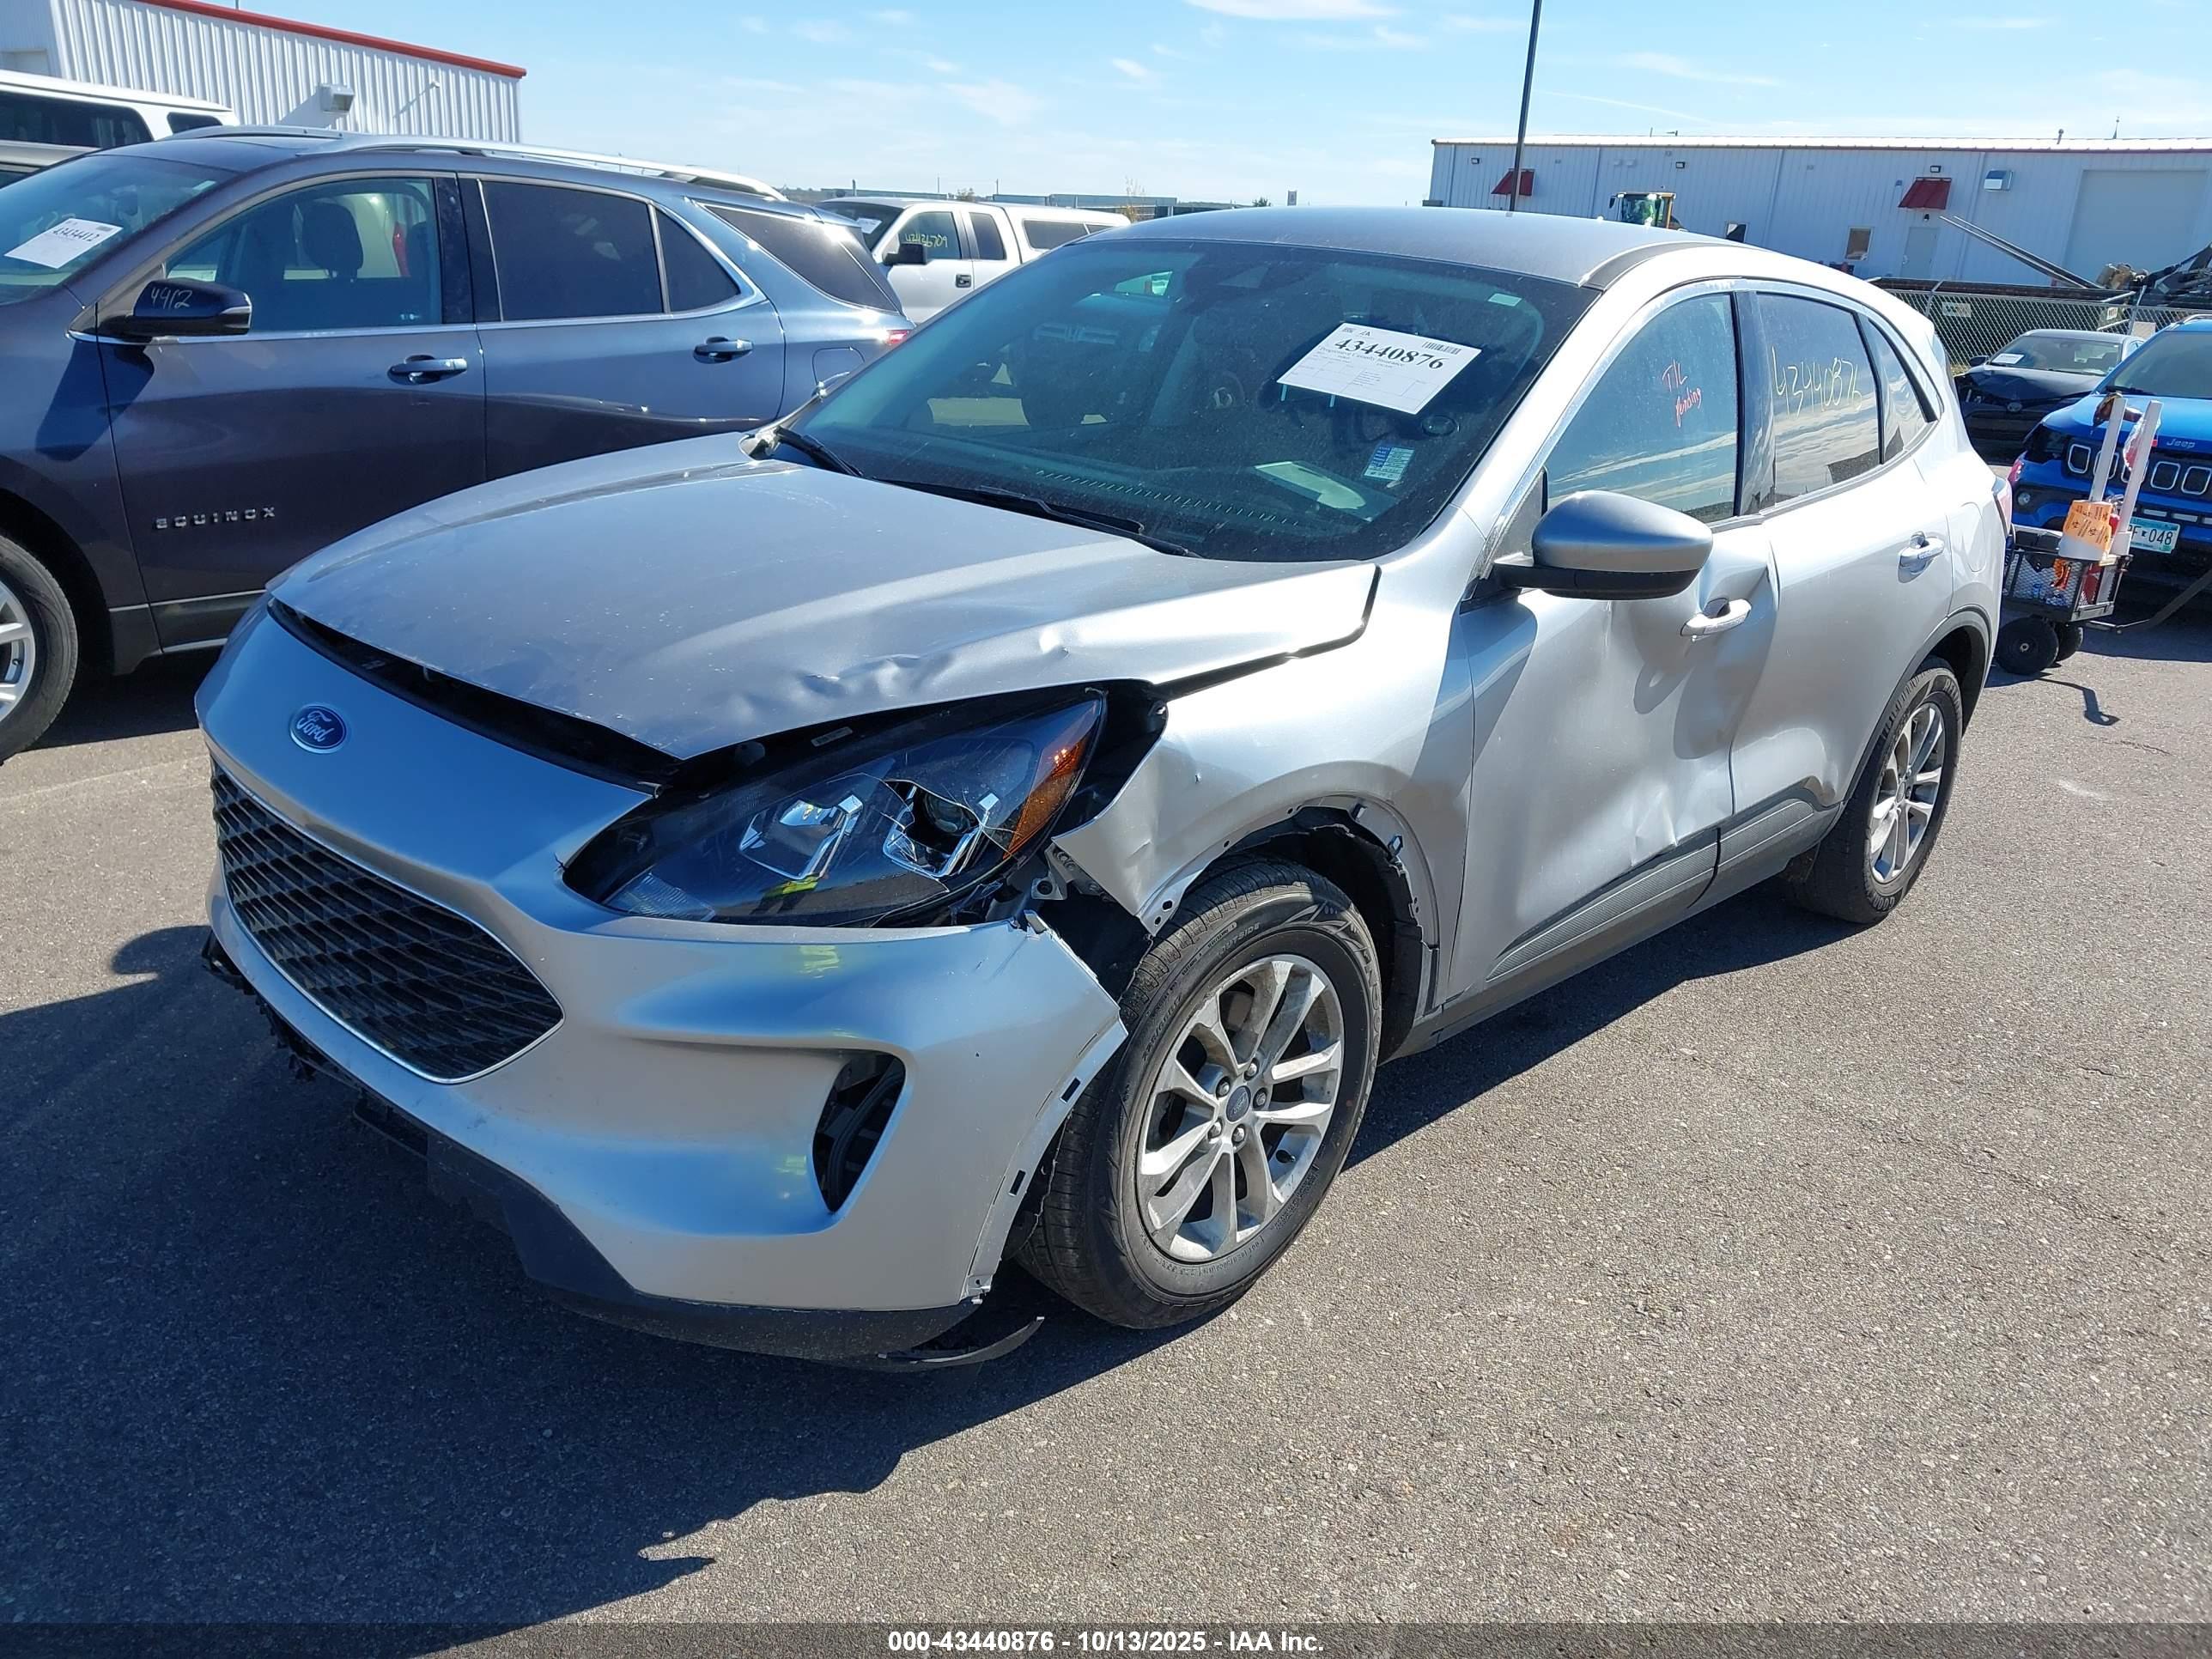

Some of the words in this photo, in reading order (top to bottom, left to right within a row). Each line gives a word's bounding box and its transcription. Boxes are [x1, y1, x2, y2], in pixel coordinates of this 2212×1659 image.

[1334, 338, 1449, 369] 43440876
[2166, 439, 2196, 449] Jeep
[155, 507, 276, 529] EQUINOX
[2148, 529, 2172, 545] 048
[296, 710, 335, 743] Ford
